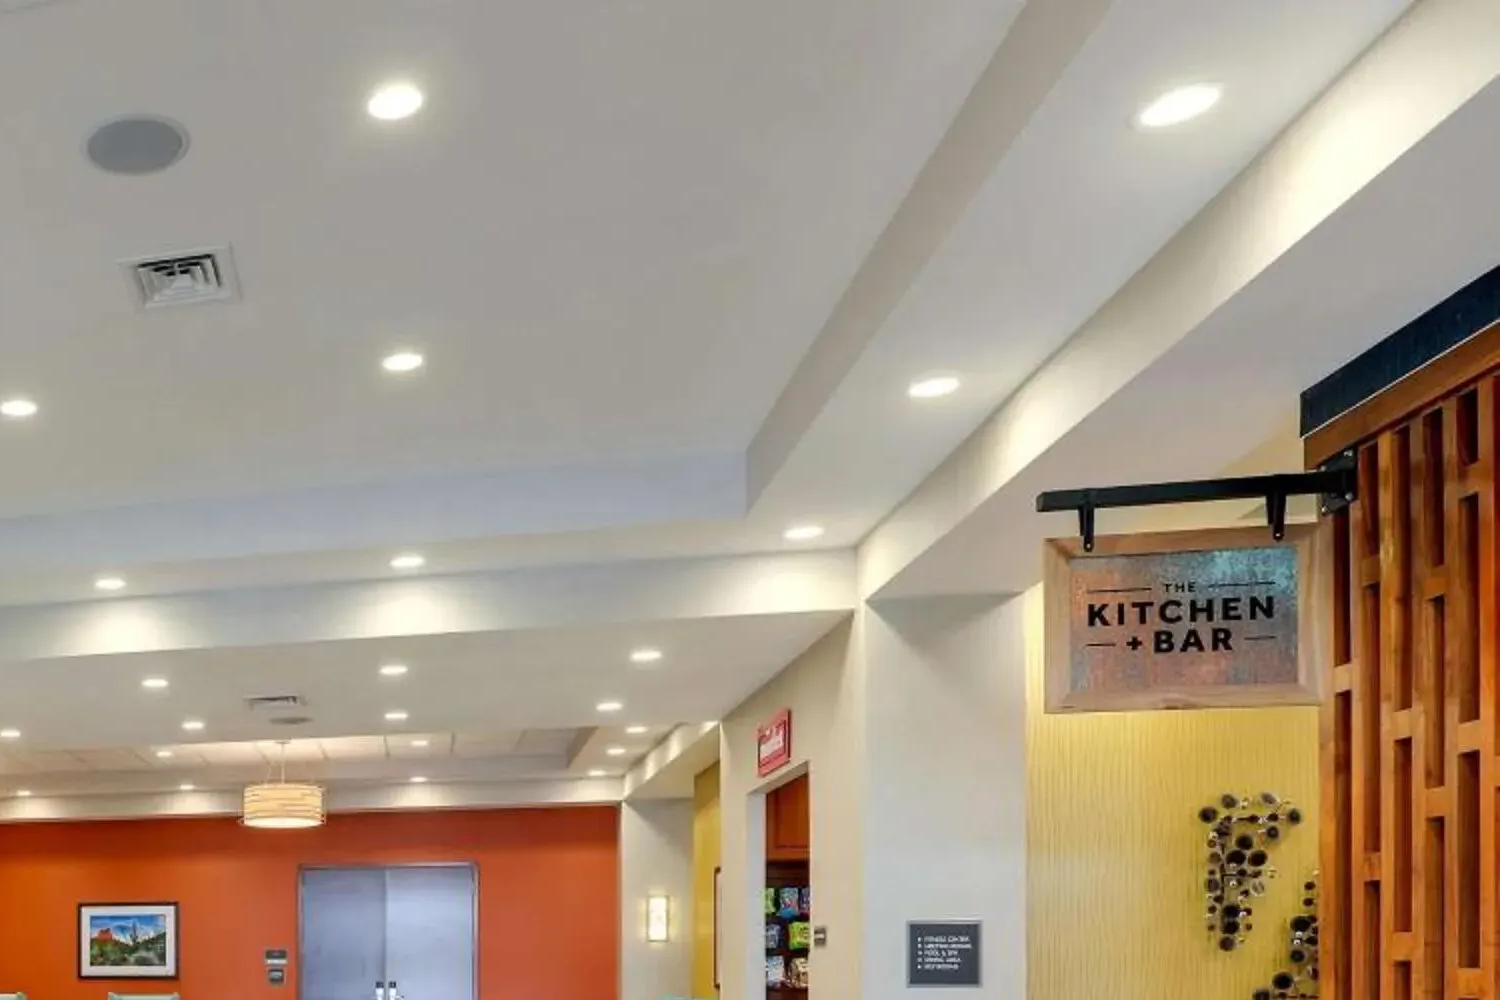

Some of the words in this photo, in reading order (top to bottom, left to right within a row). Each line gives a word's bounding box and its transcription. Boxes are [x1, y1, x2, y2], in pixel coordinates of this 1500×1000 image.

[1163, 582, 1197, 593] THE
[1087, 595, 1275, 627] KITCHEN
[1153, 627, 1234, 653] BAR
